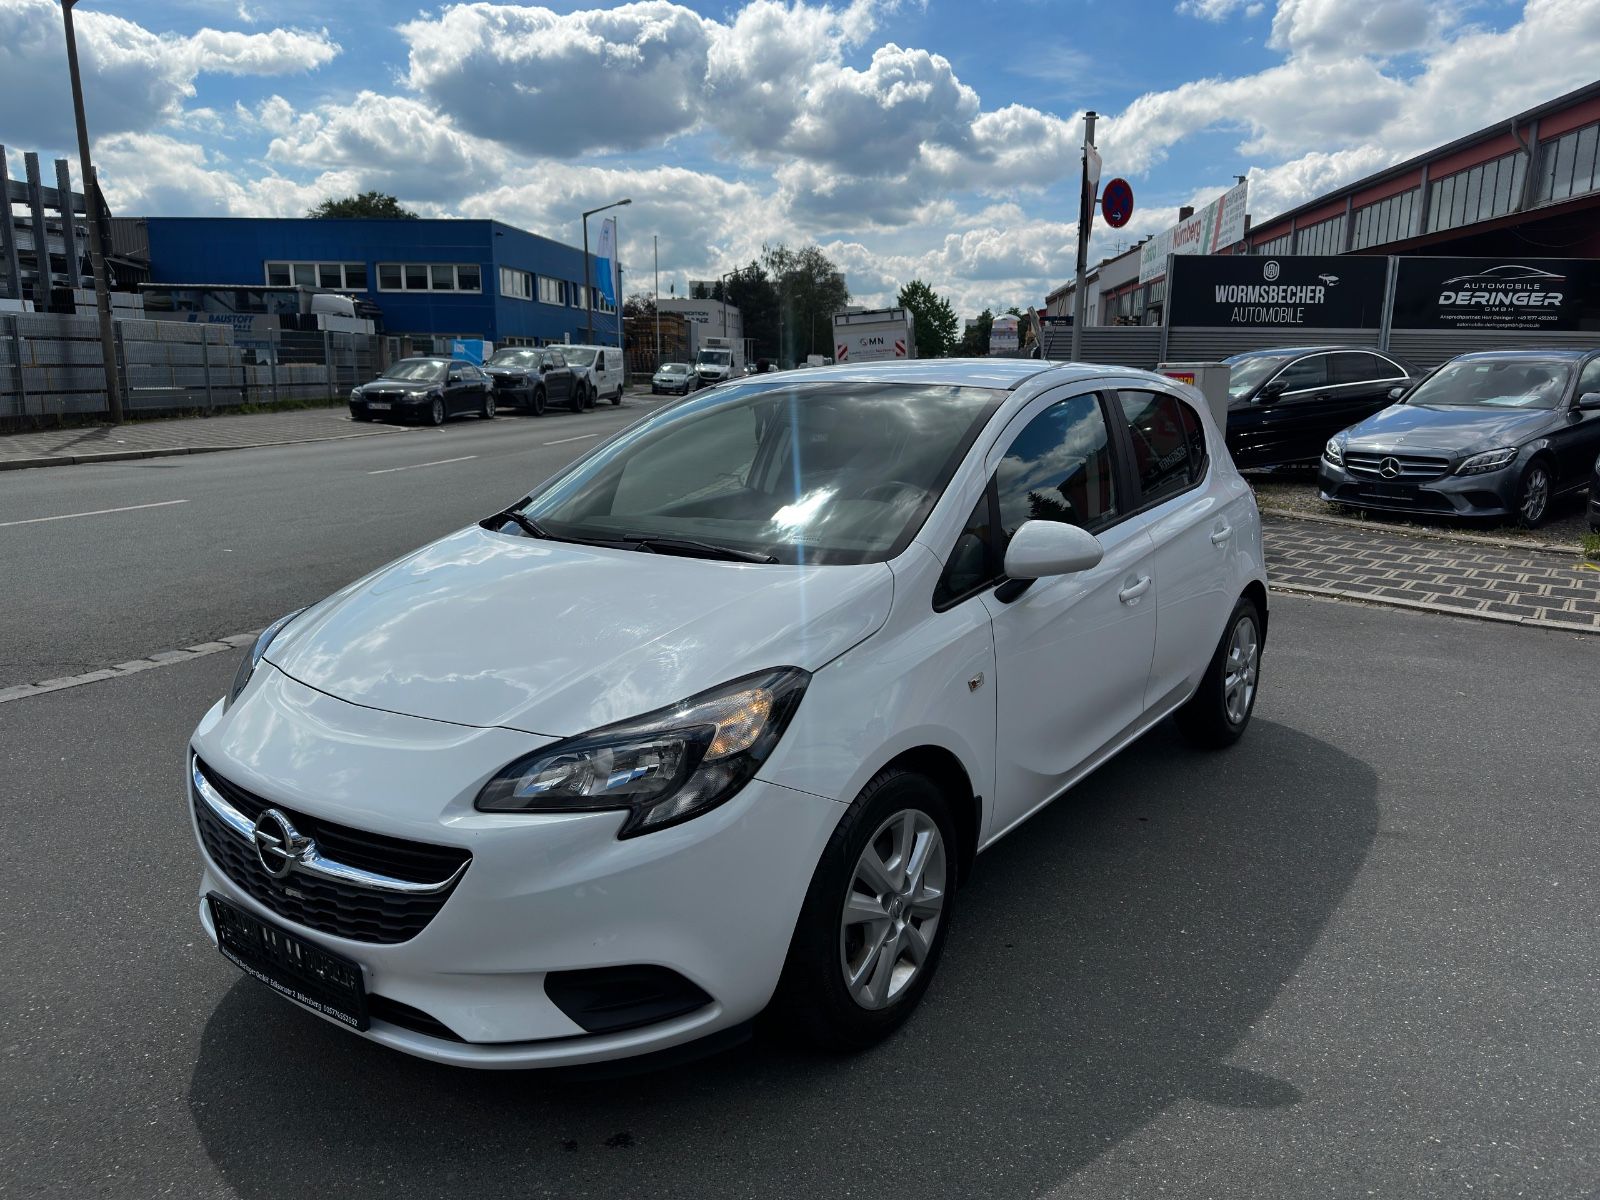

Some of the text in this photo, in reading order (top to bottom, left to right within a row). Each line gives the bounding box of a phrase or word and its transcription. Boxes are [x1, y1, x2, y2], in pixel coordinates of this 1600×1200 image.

[1172, 218, 1202, 250] Nürnberg
[1215, 284, 1325, 304] WORMSBECHER
[1438, 291, 1564, 306] DERINGER
[1231, 306, 1305, 323] AUTOMOBILE
[297, 992, 322, 1011] Nürnberg
